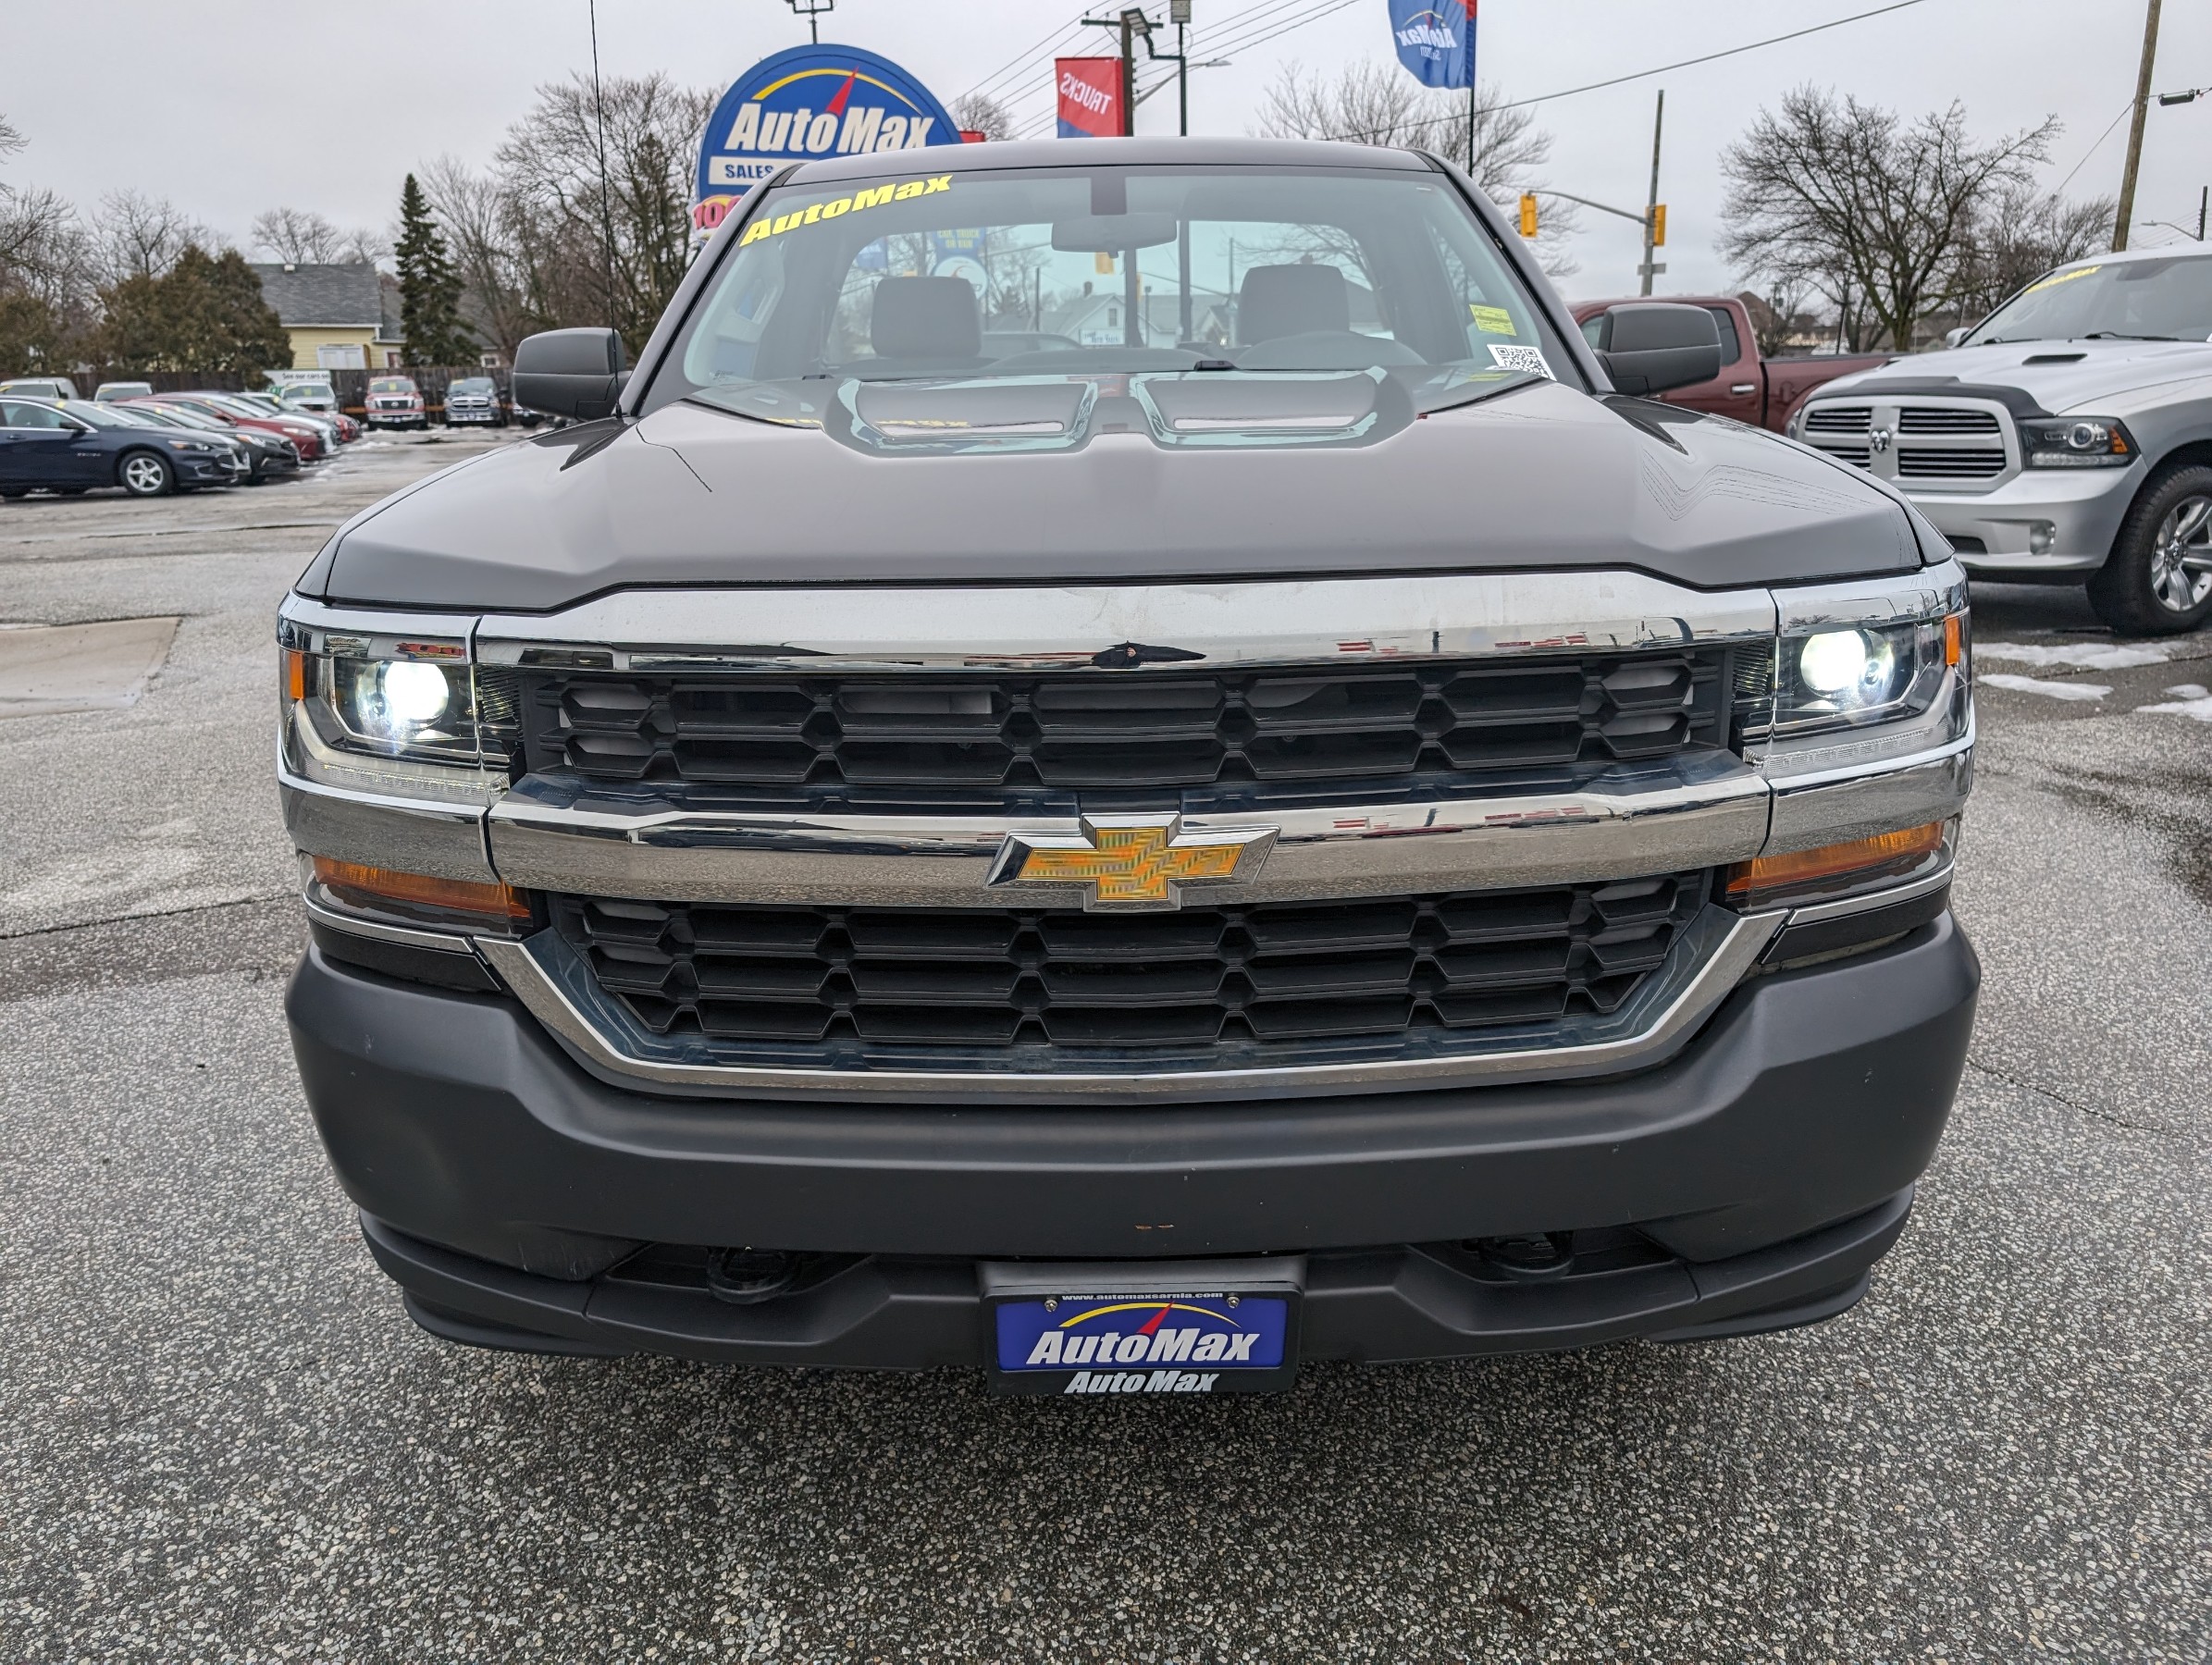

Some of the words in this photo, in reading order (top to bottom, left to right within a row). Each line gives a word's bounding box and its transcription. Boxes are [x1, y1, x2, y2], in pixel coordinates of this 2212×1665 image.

[725, 164, 774, 179] SALES
[739, 175, 954, 247] AutoMax
[1061, 1292, 1224, 1301] www.automaxsarnia.com
[1026, 1328, 1260, 1364] AutoMax
